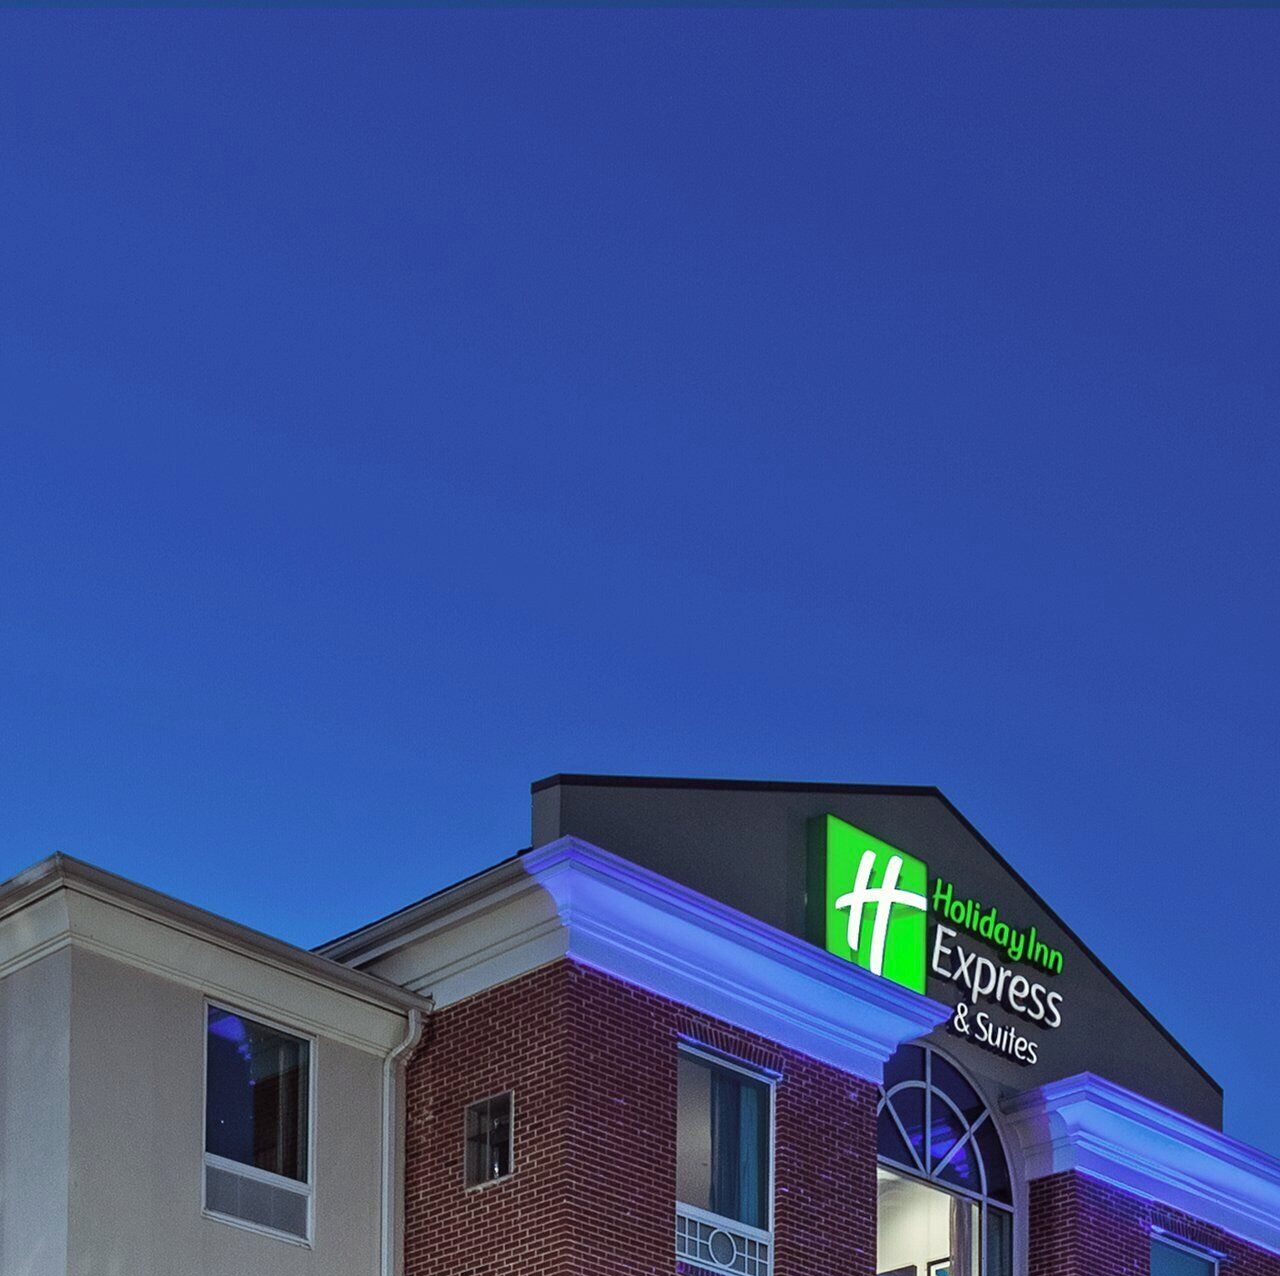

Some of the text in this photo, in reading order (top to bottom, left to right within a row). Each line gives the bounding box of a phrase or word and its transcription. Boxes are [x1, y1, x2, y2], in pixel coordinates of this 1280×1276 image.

[932, 878, 1063, 974] Holiday Inn
[932, 924, 1063, 1028] Express
[954, 1003, 1038, 1065] & Suites
